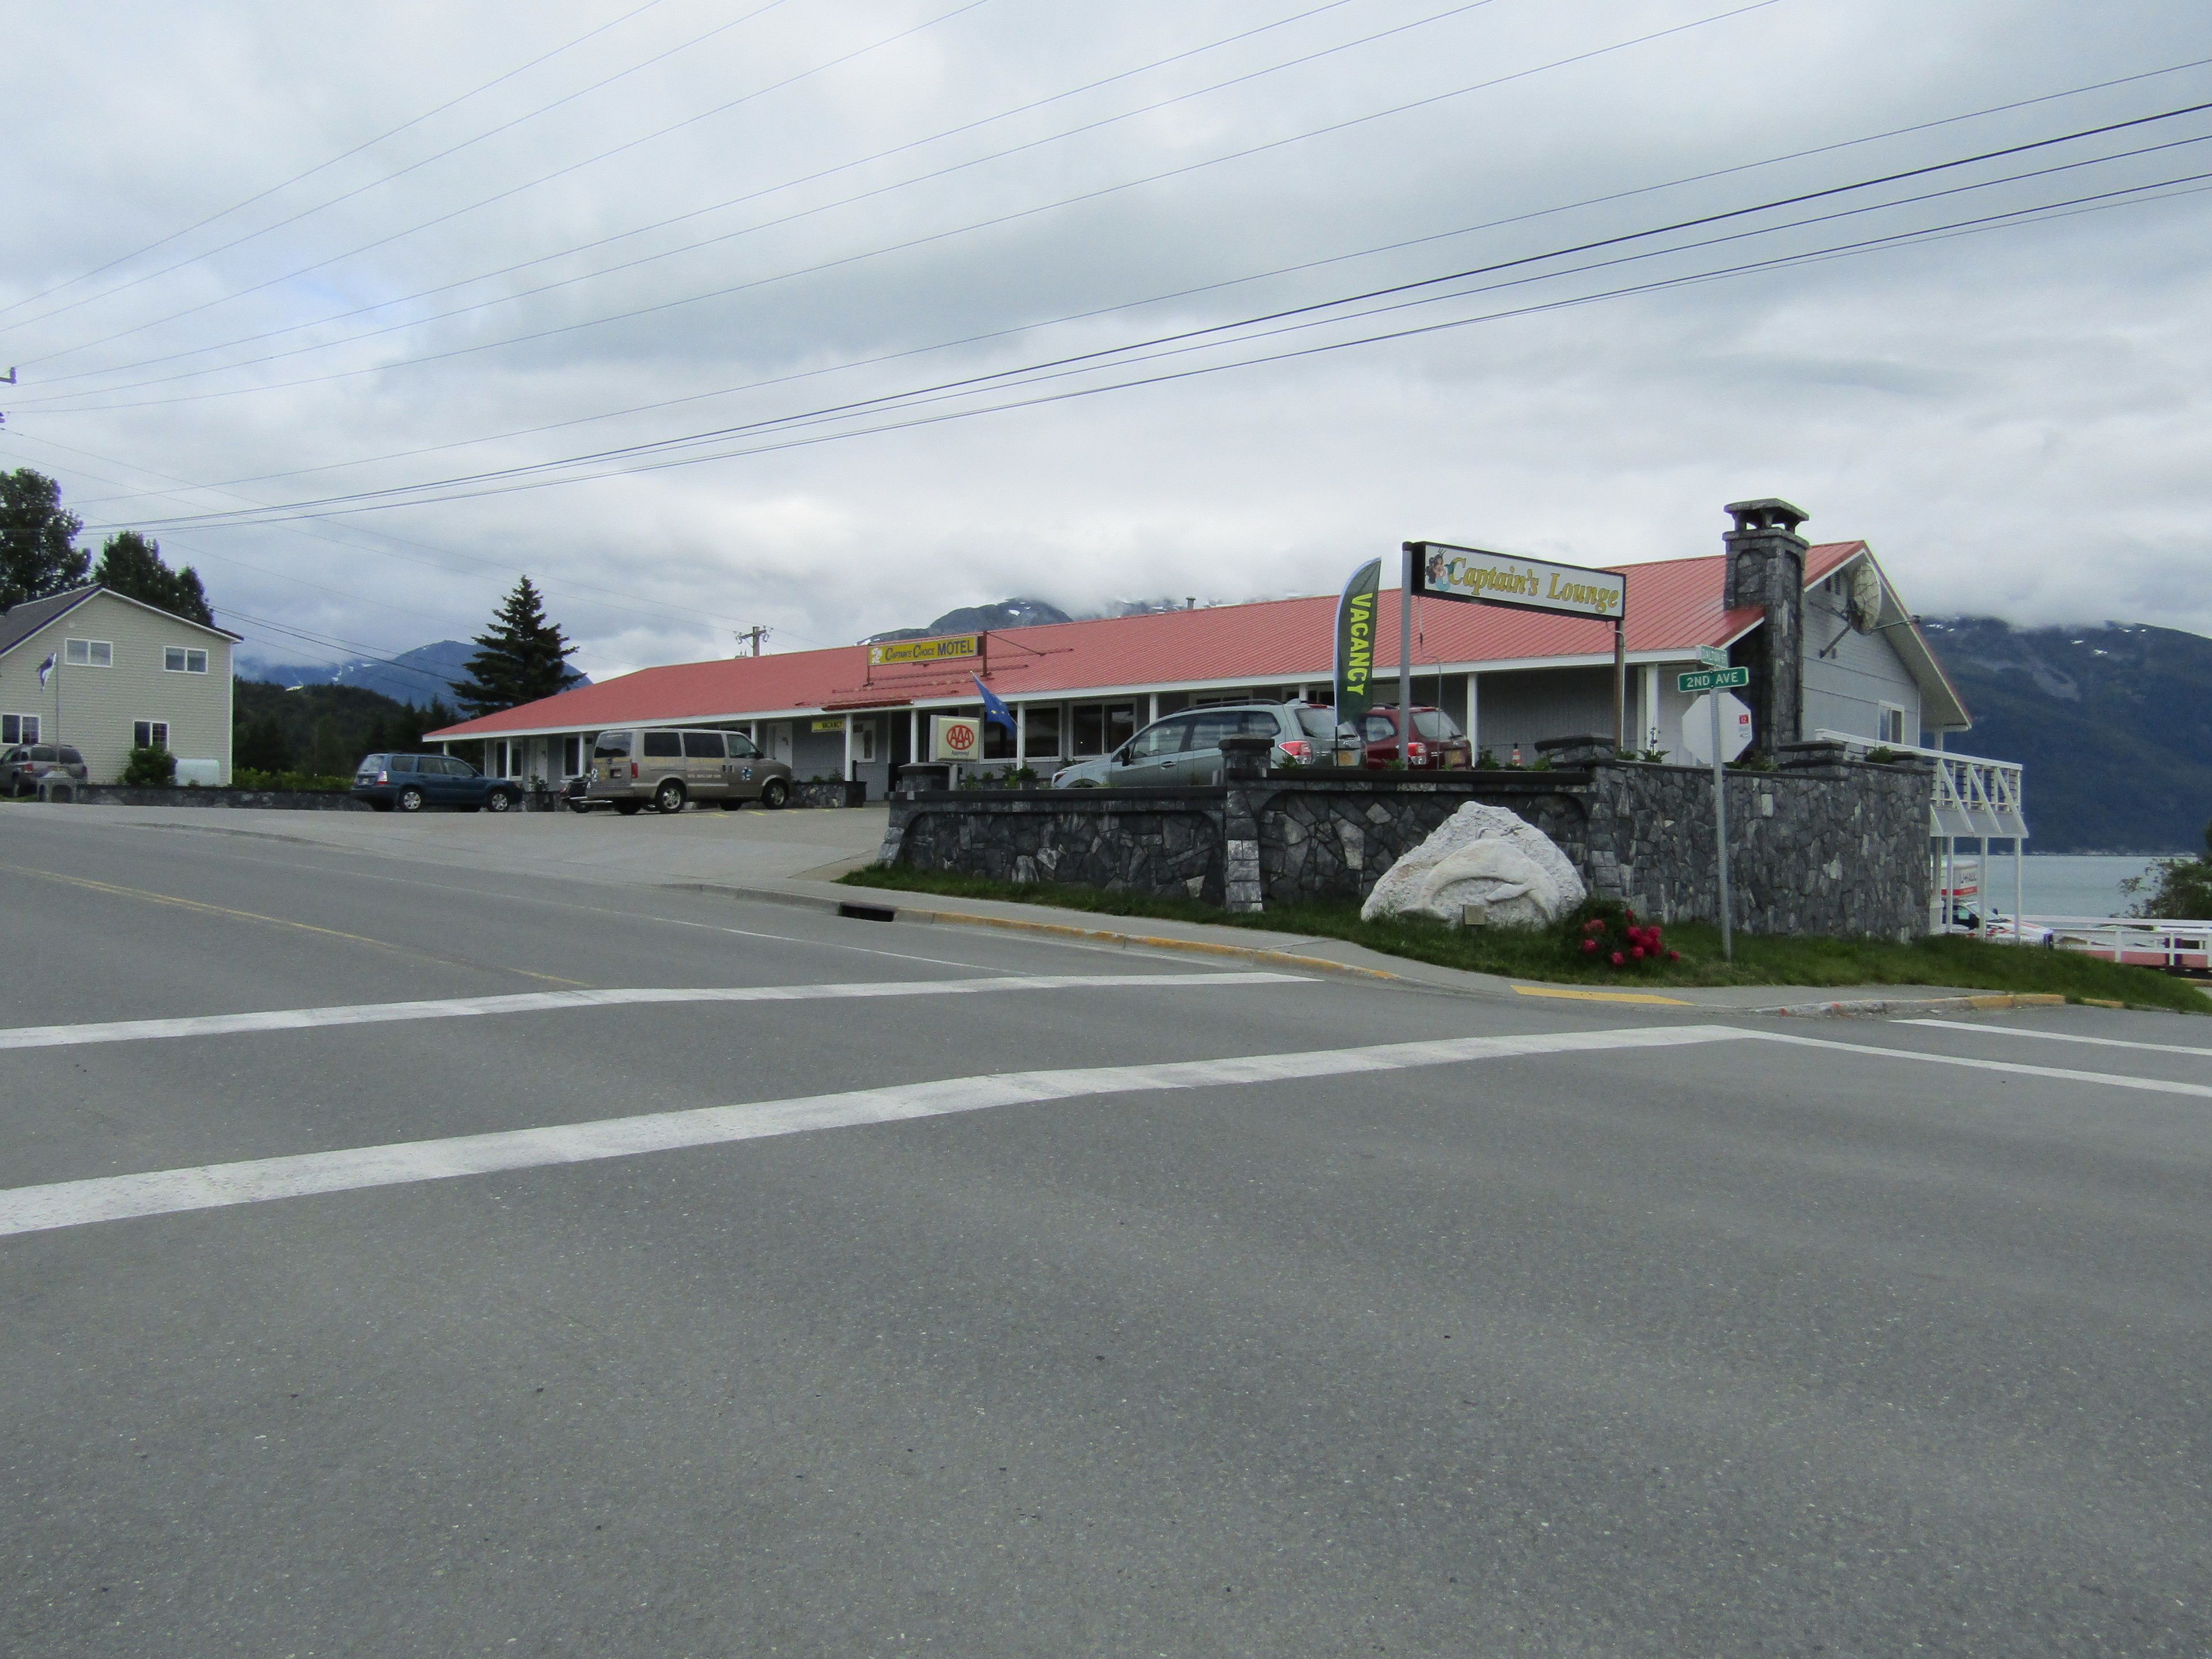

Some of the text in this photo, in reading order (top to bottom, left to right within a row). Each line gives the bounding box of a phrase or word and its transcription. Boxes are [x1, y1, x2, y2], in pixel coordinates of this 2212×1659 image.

[1449, 557, 1619, 613] Captain's Lounge
[937, 640, 974, 656] MOTEL
[1347, 593, 1373, 695] VACANCY
[1687, 672, 1738, 687] 2ND AVE
[948, 726, 972, 749] AAA
